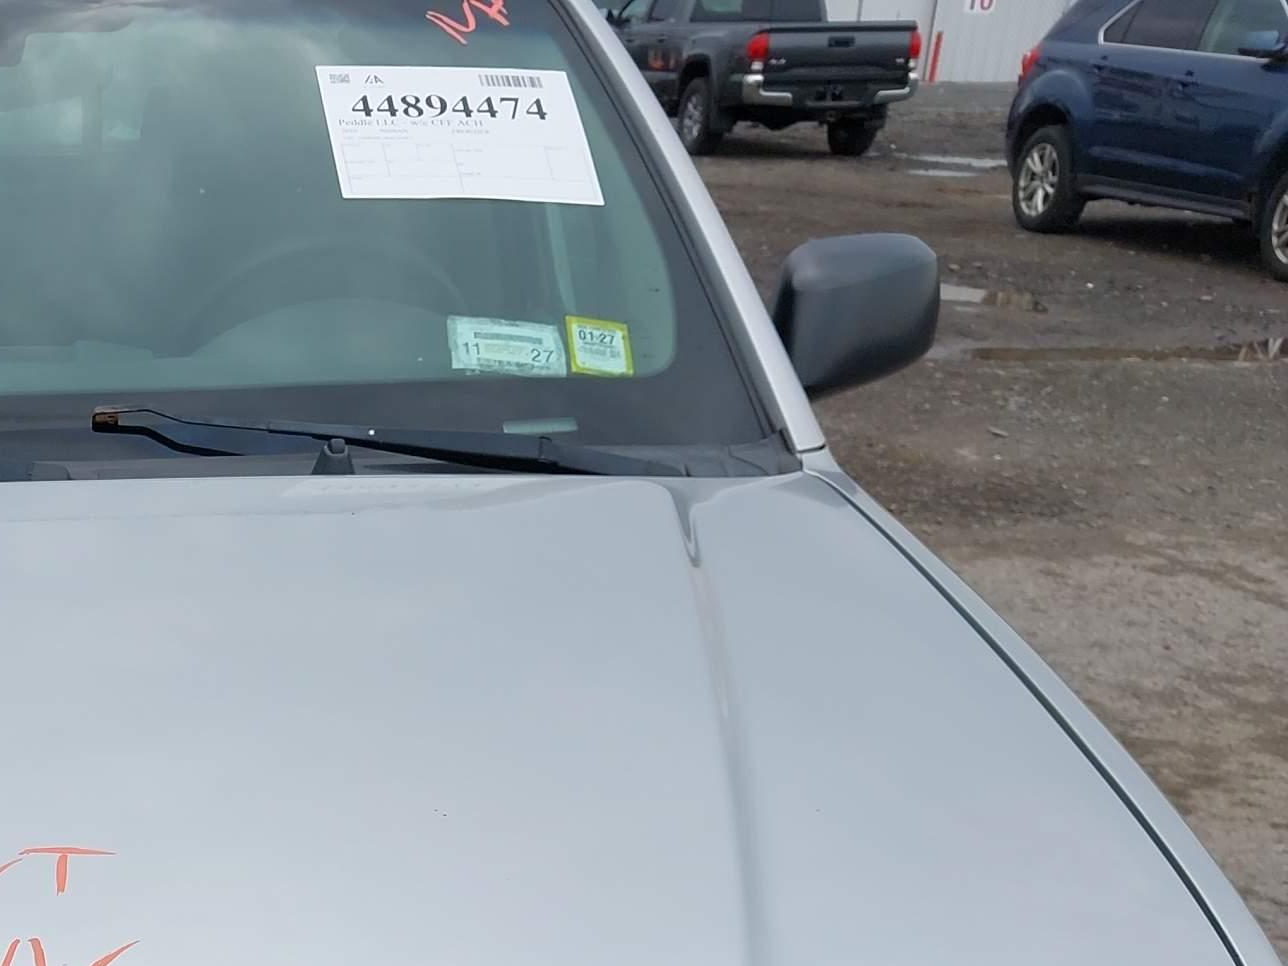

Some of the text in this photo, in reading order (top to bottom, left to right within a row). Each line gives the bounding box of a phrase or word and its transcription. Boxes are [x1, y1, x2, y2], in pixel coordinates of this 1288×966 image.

[352, 94, 548, 121] 44894474
[462, 341, 554, 363] 11 27
